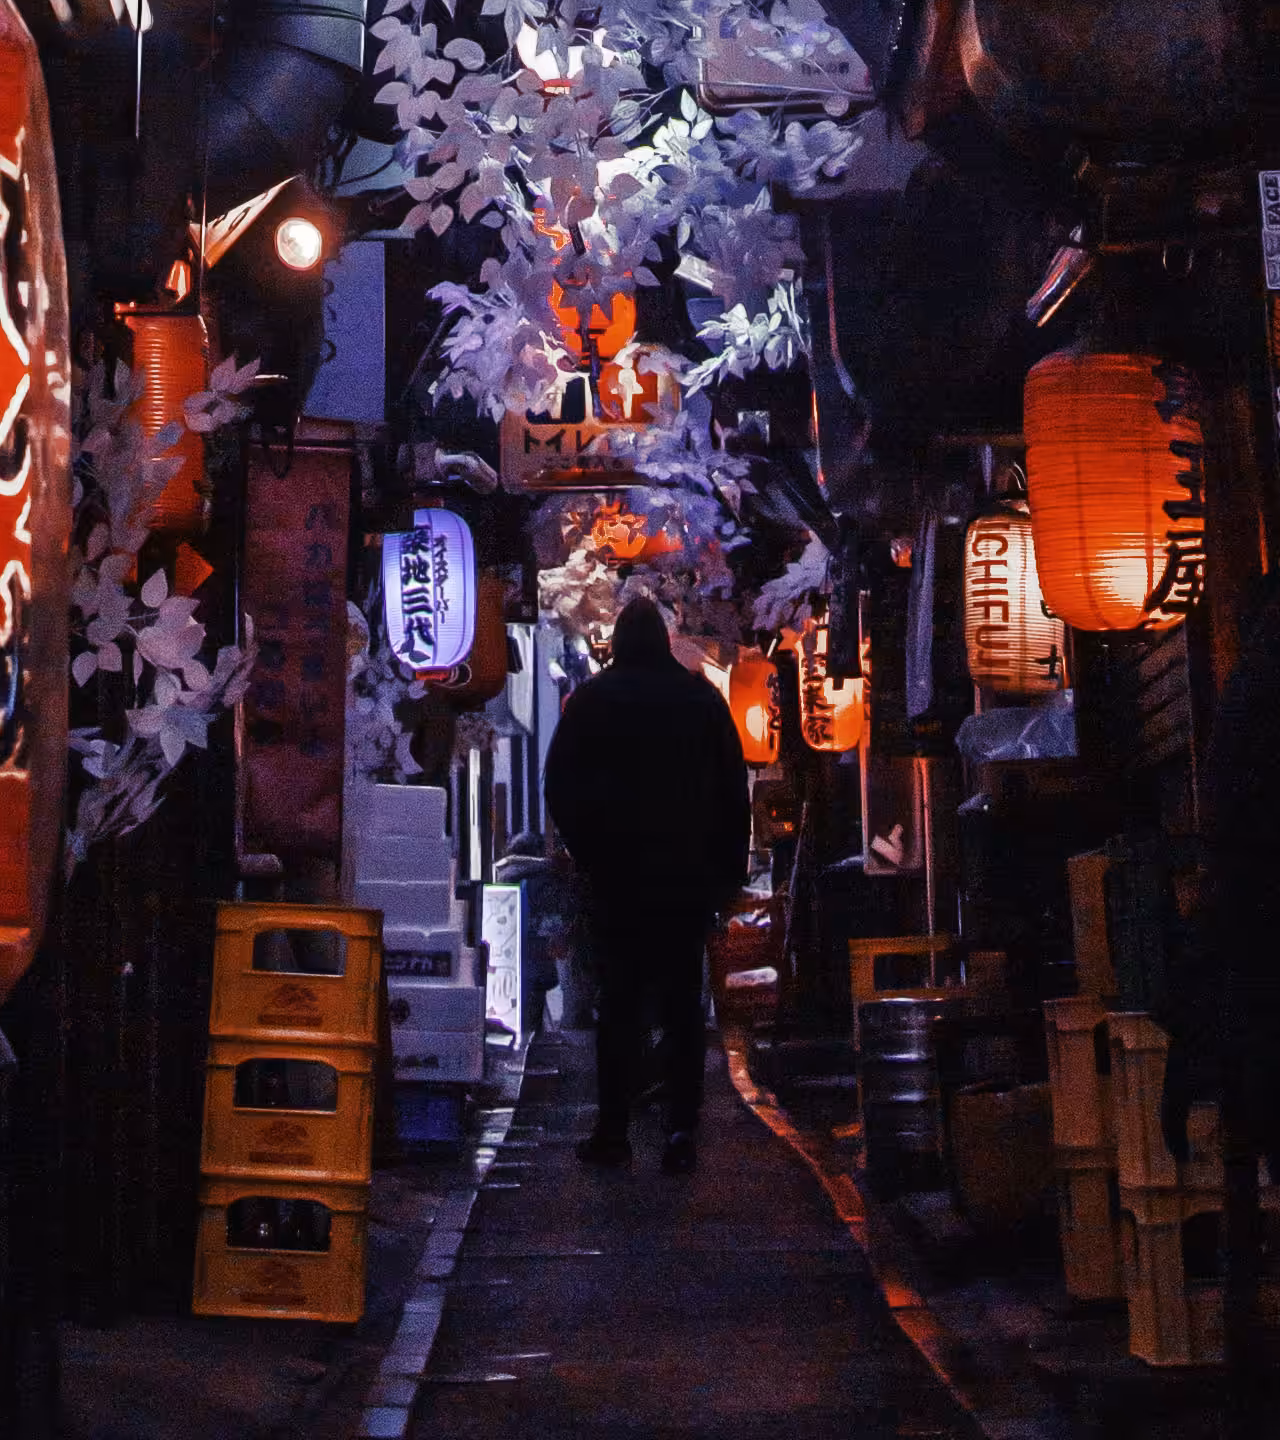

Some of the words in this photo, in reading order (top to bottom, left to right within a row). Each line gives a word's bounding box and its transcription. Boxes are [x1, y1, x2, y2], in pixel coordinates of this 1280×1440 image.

[433, 534, 450, 625] オイスターバー
[972, 522, 1011, 681] ICHIFUJI
